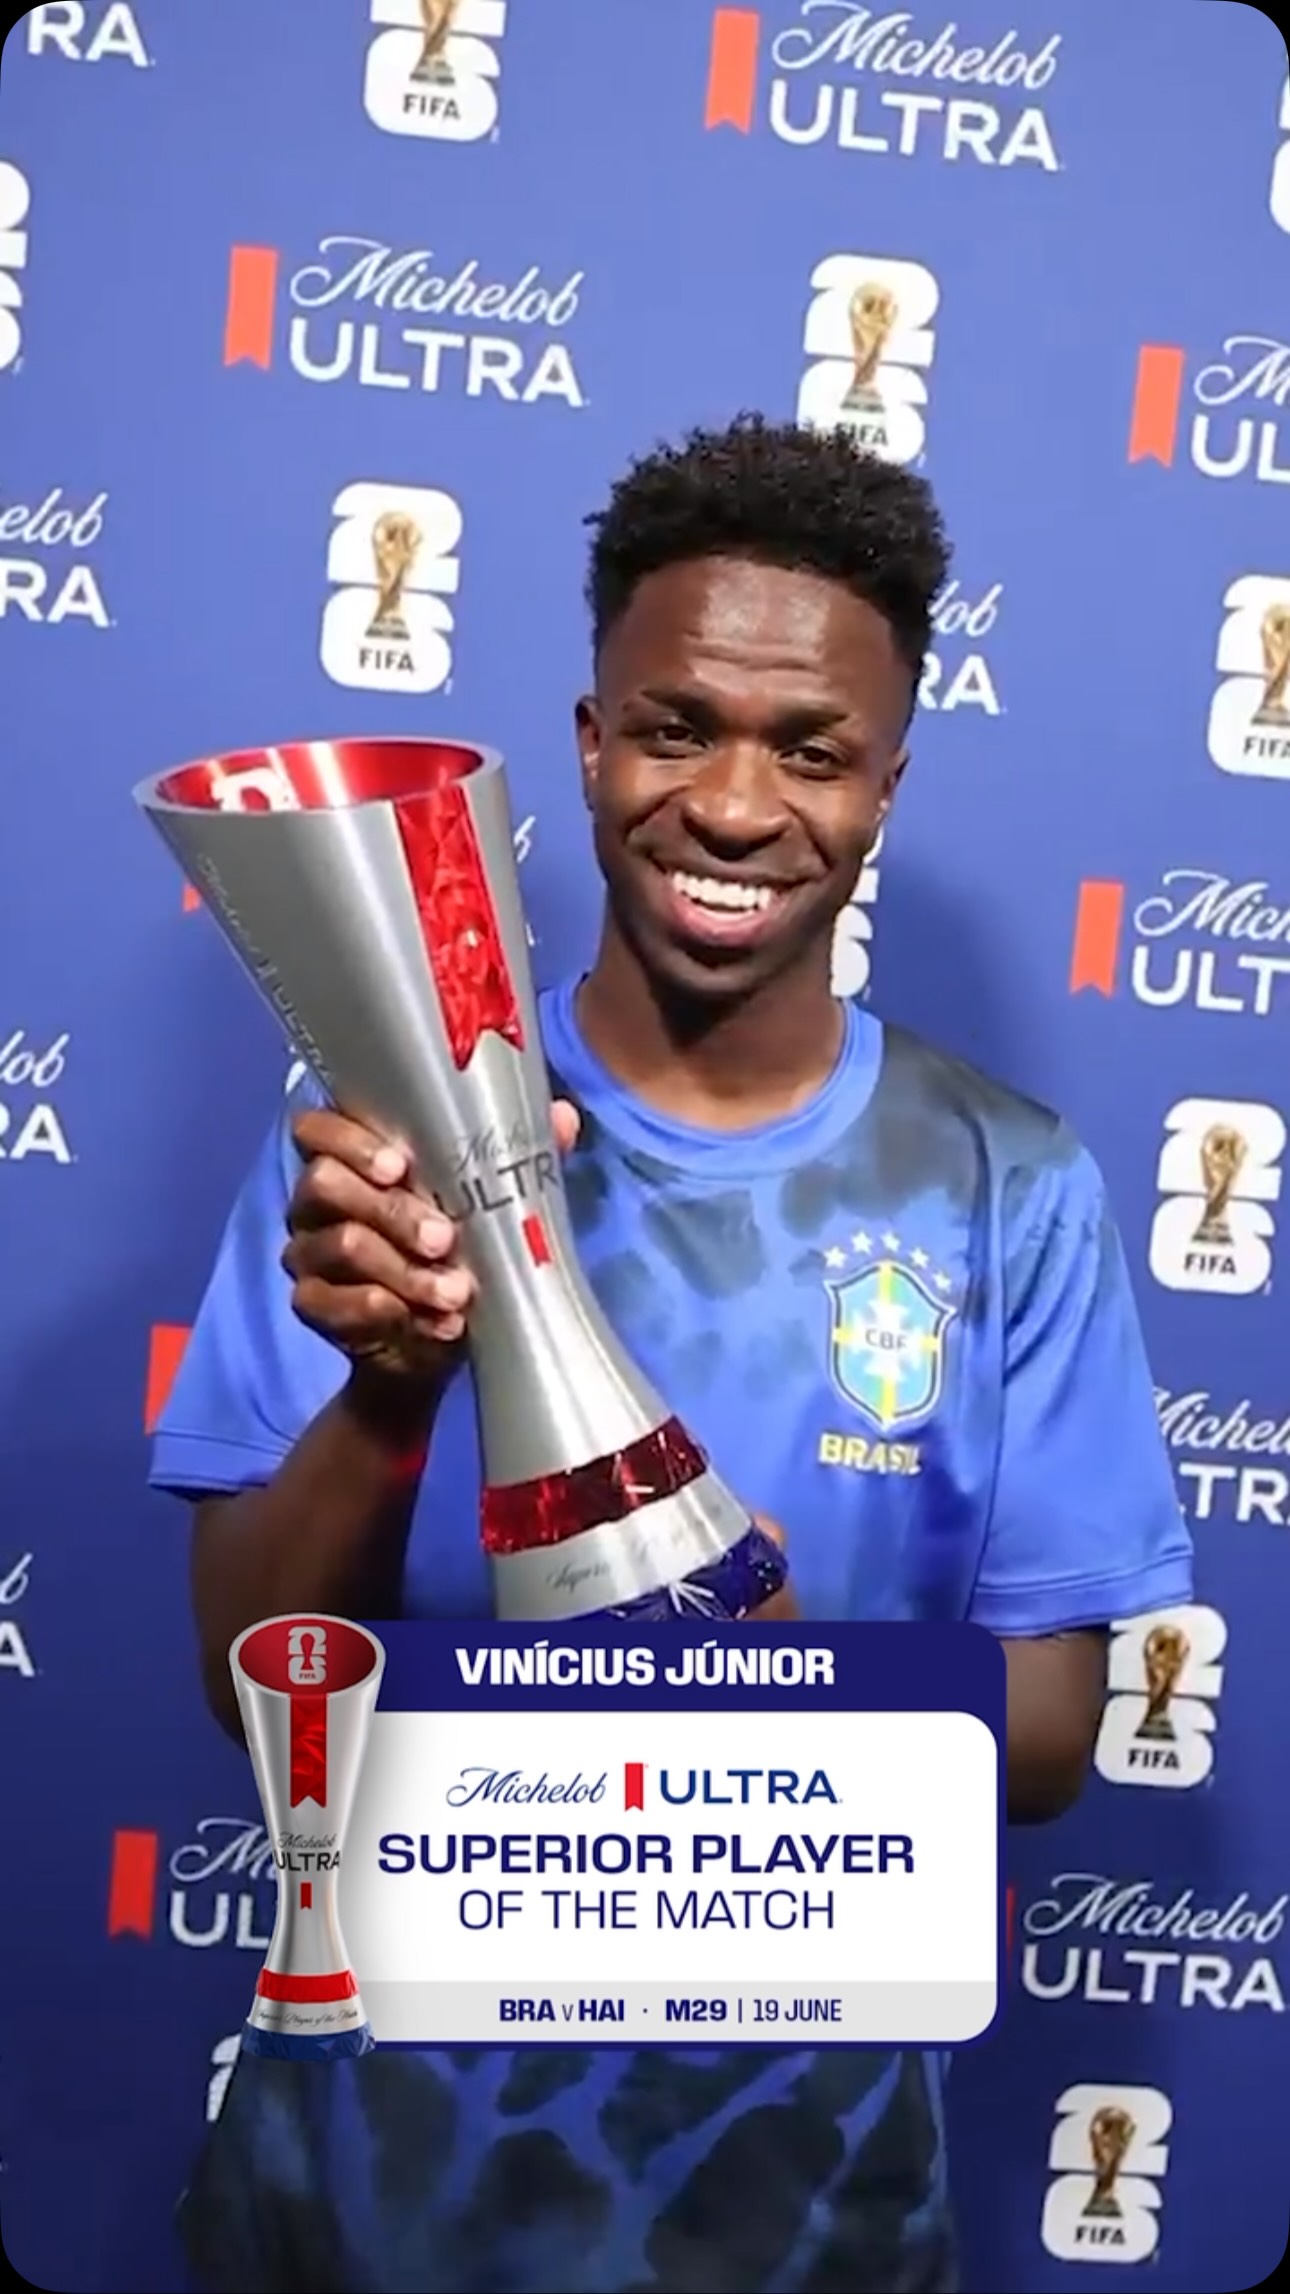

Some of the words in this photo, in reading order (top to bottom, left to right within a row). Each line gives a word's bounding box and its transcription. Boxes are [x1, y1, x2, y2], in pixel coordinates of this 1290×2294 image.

[771, 0, 1062, 90] Michelob
[402, 93, 460, 120] FIFA
[769, 79, 1059, 171] ULTRA
[290, 236, 584, 326] Michelob
[289, 317, 582, 407] ULTRA
[359, 648, 415, 673] FIFA
[1183, 1252, 1237, 1275] FIFA
[864, 1328, 907, 1351] CBF
[820, 1431, 922, 1475] BRASIL
[1128, 1747, 1181, 1771] FIFA
[1023, 1872, 1290, 1944] Michelob
[1022, 1943, 1285, 2013] ULTRA
[1074, 2225, 1126, 2245] FIFA
